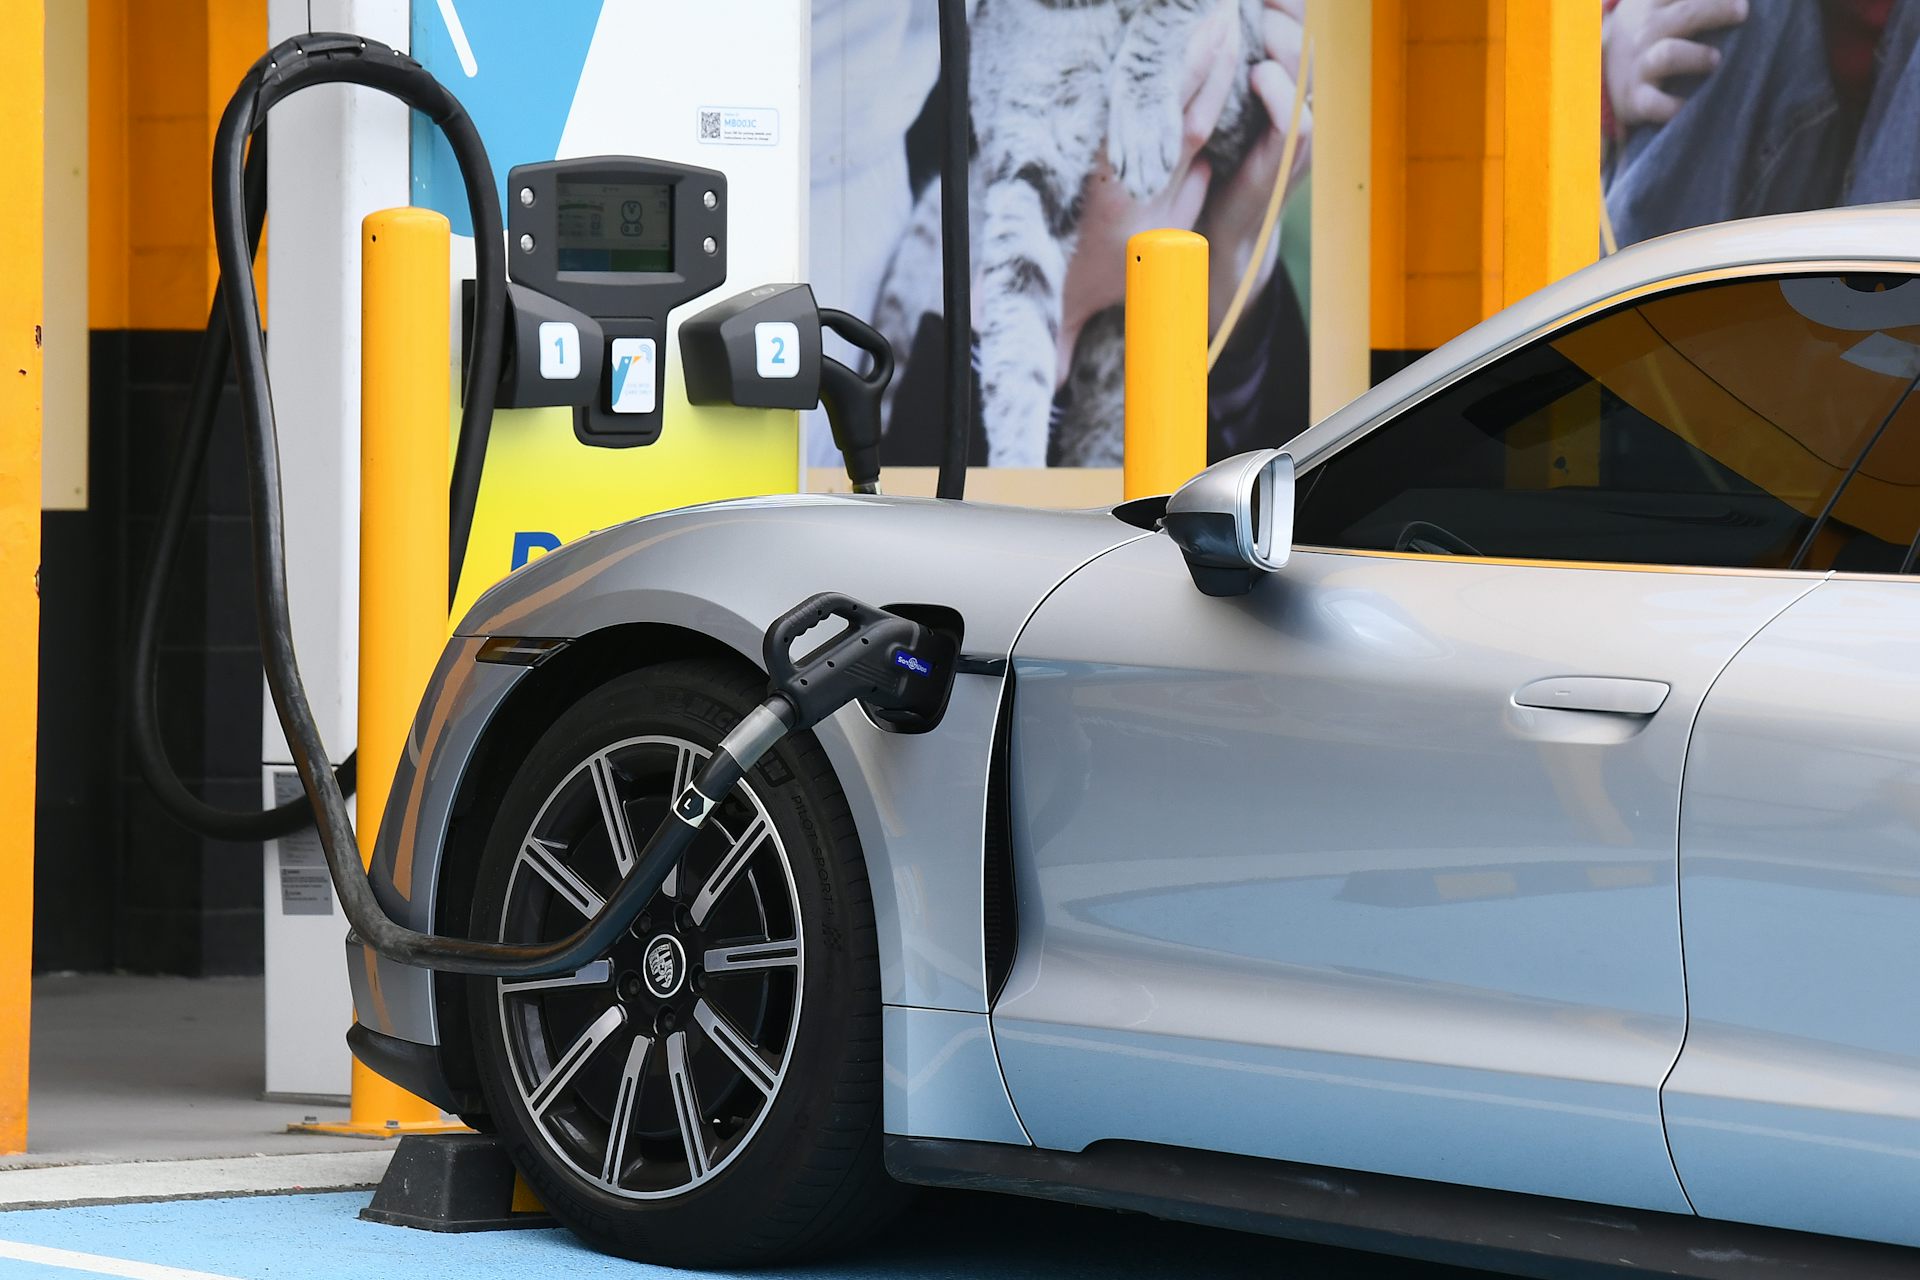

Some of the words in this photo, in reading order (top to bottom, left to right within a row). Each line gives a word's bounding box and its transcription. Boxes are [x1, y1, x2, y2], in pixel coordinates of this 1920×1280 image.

[553, 336, 565, 365] 1
[770, 336, 785, 364] 2
[791, 795, 818, 842] PILOT
